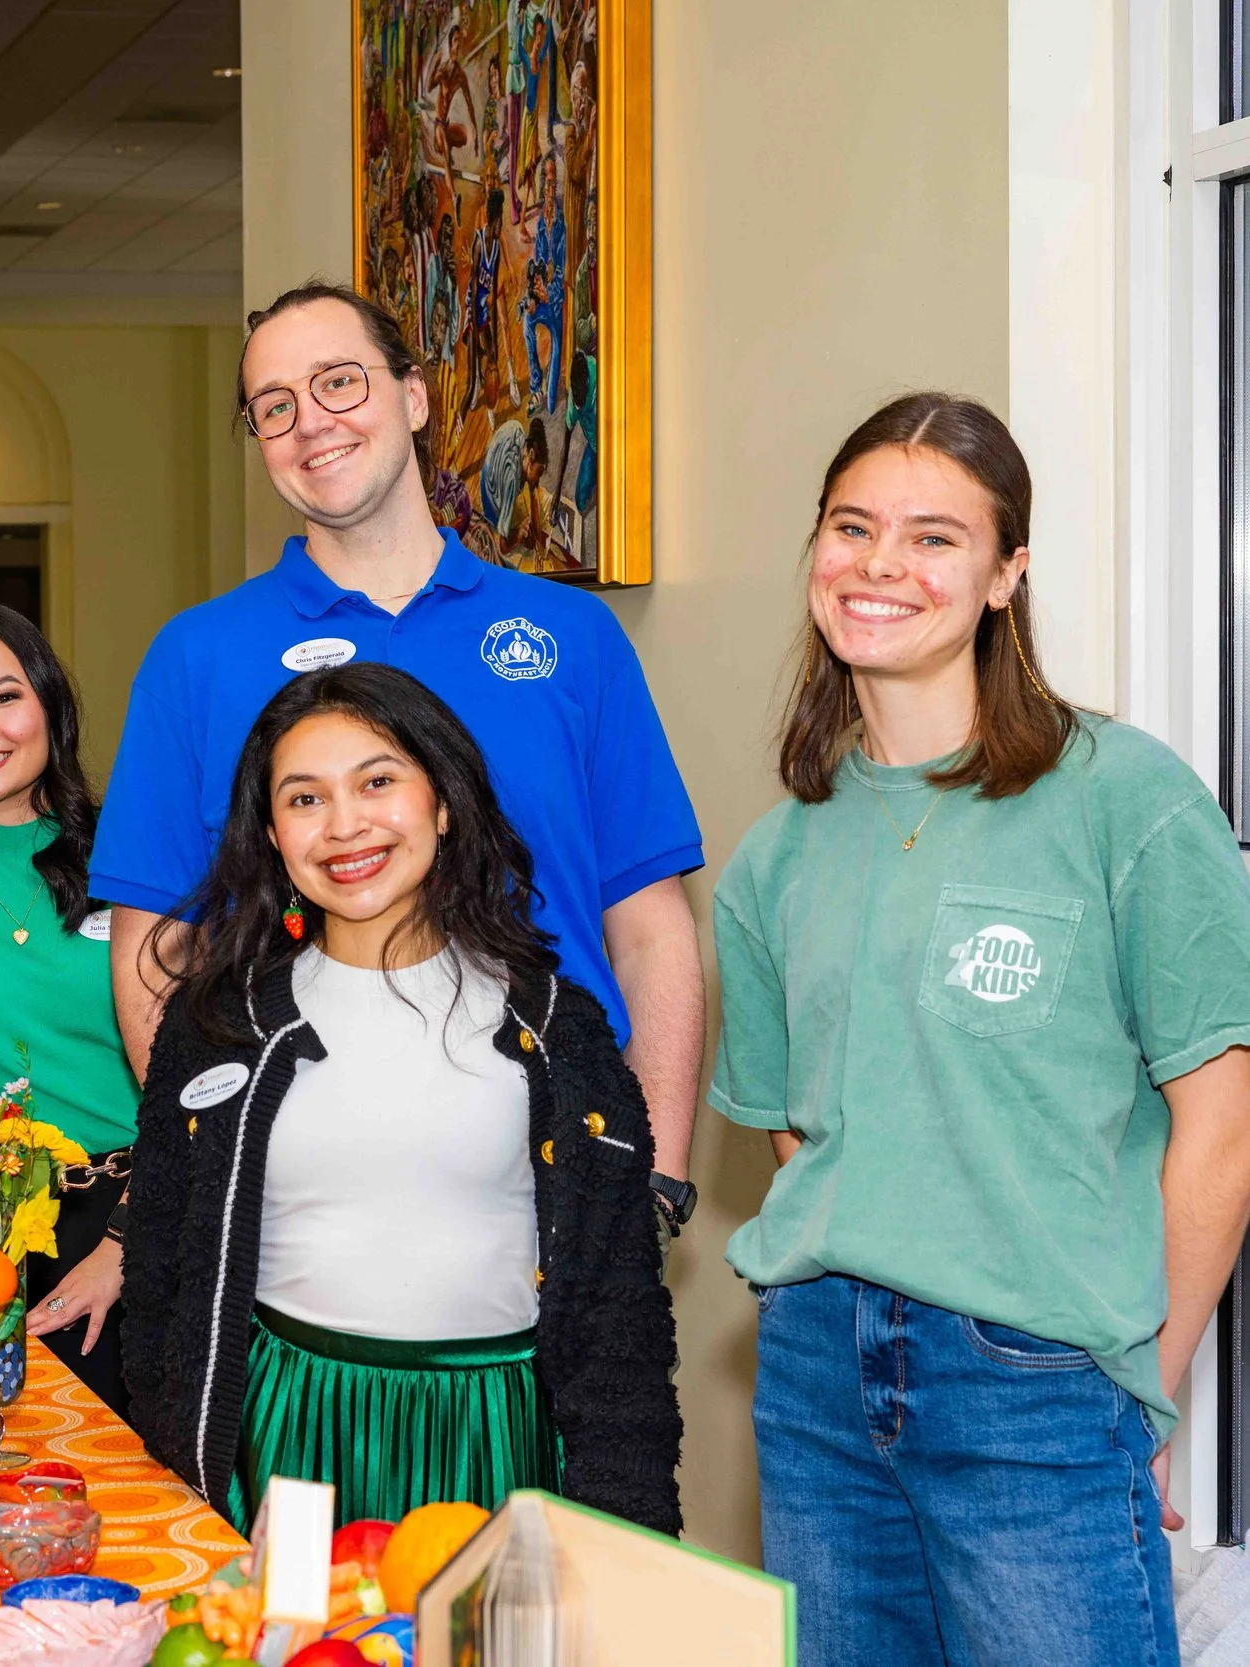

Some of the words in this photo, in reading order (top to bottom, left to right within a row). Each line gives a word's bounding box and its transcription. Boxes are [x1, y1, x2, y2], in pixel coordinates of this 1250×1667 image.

[490, 621, 517, 638] FOOD
[520, 620, 546, 640] BANK
[313, 651, 345, 661] Fitzgerald
[969, 936, 1038, 970] FOOD
[971, 965, 1038, 996] KIDS
[189, 1087, 216, 1100] Brittany
[217, 1080, 237, 1090] Lopez
